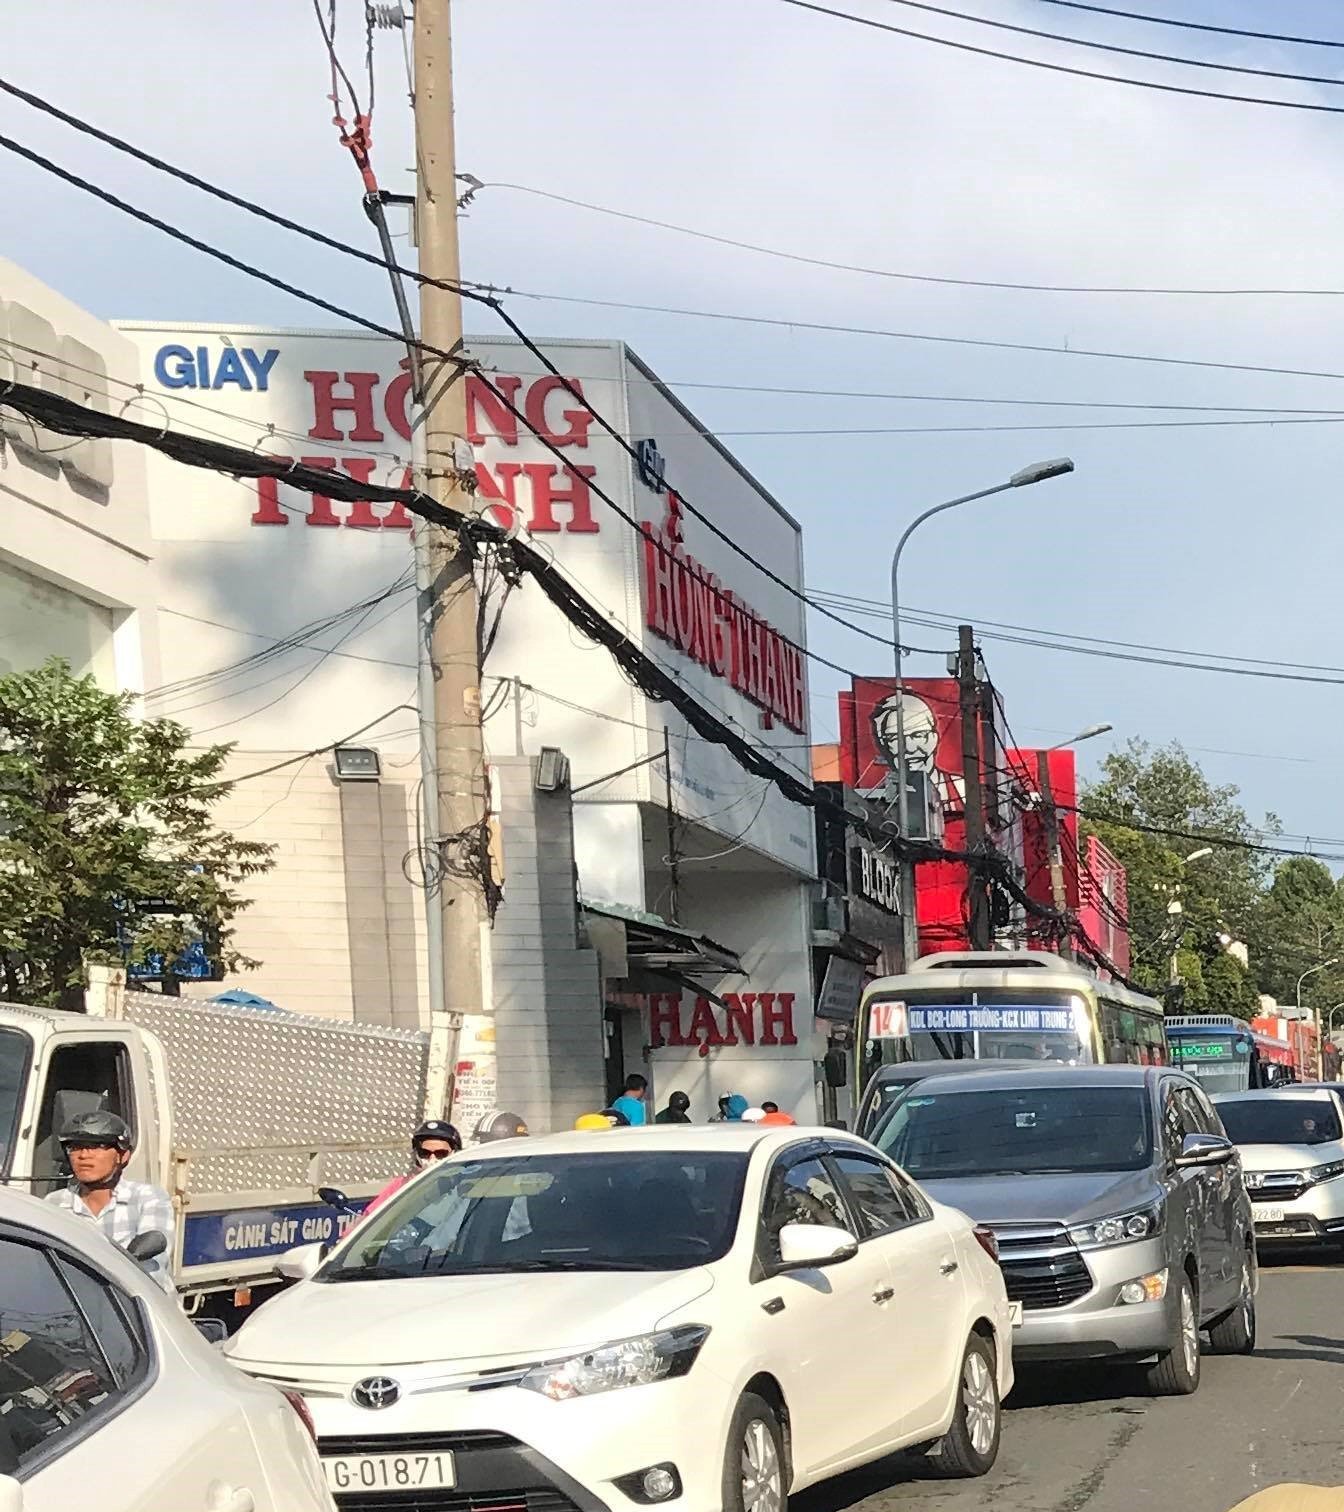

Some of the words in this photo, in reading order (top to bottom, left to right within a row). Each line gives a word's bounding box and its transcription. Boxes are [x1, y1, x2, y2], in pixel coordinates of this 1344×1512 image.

[154, 335, 280, 391] GIÀY
[225, 1220, 266, 1251] CẢNH
[269, 1216, 298, 1244] SÁT
[302, 1217, 331, 1240] GIAO
[321, 1456, 444, 1488] 1G-018.71
